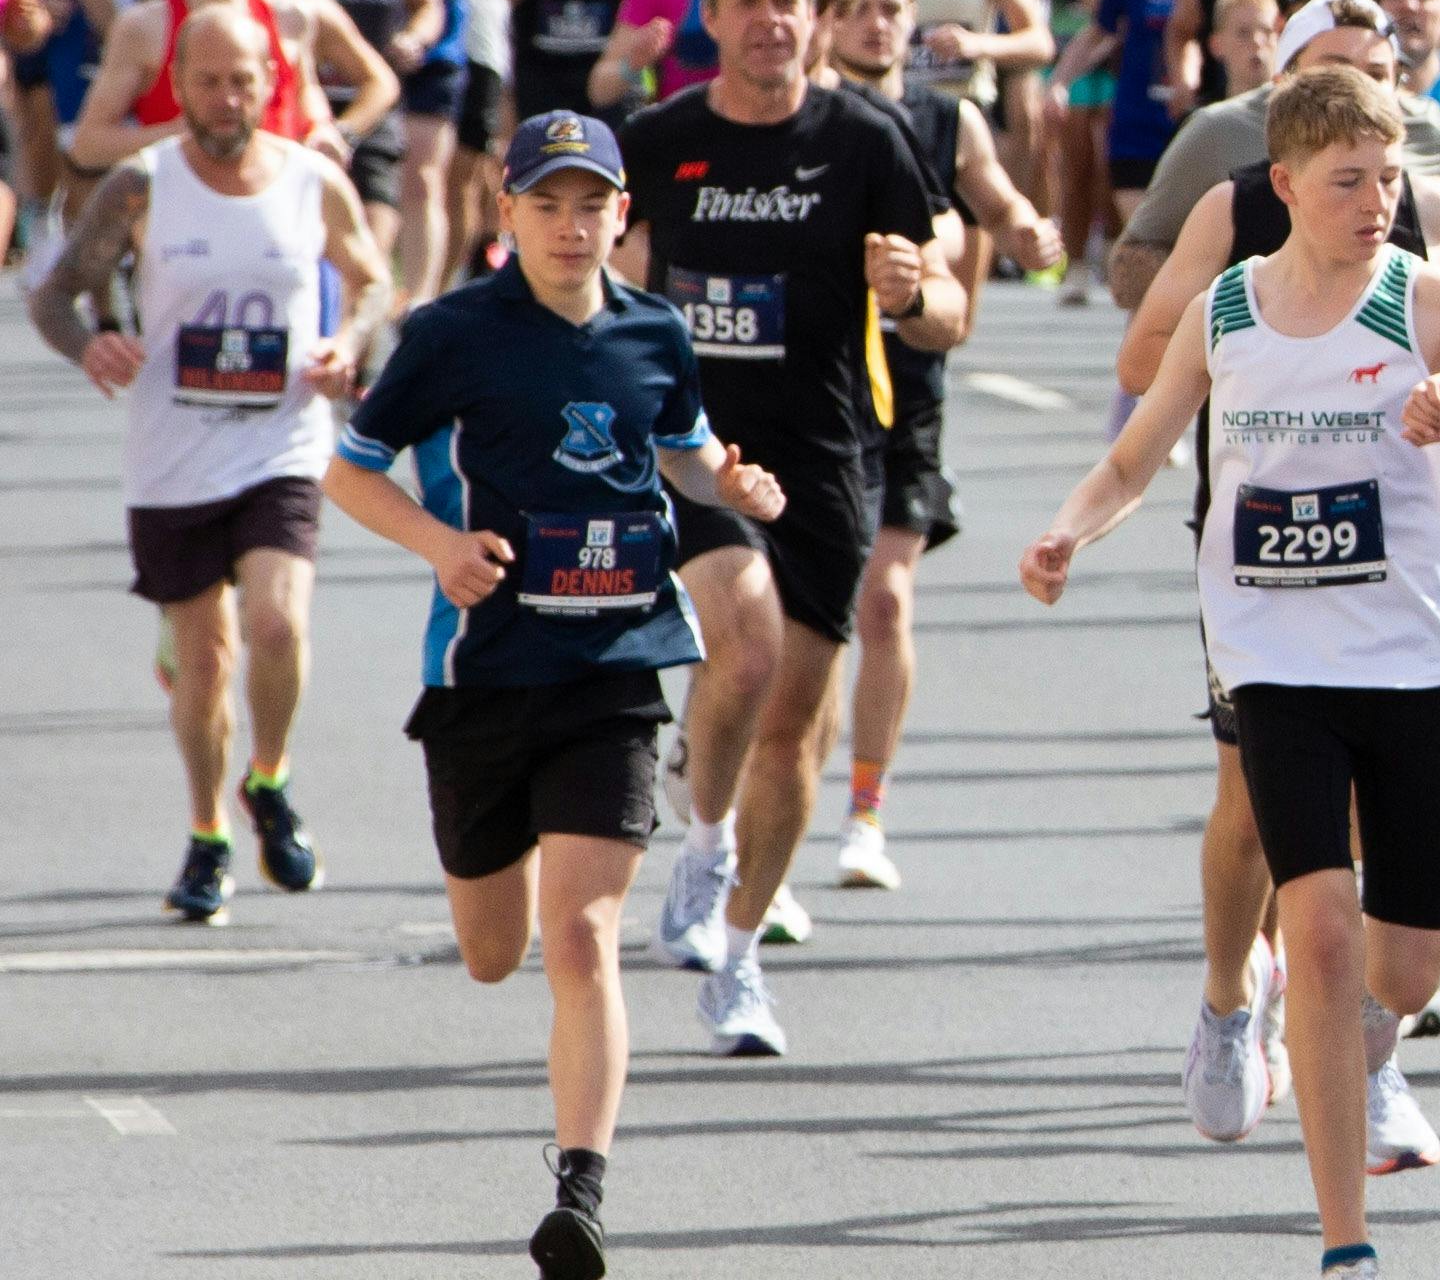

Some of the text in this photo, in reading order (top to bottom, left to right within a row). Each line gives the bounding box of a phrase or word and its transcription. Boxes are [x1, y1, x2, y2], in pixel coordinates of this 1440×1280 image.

[1221, 410, 1387, 428] NORTH WEST
[1225, 431, 1379, 446] ATHLETICS CLUB
[1257, 521, 1358, 562] 2299
[578, 547, 617, 570] 978
[551, 569, 636, 596] DENNIS
